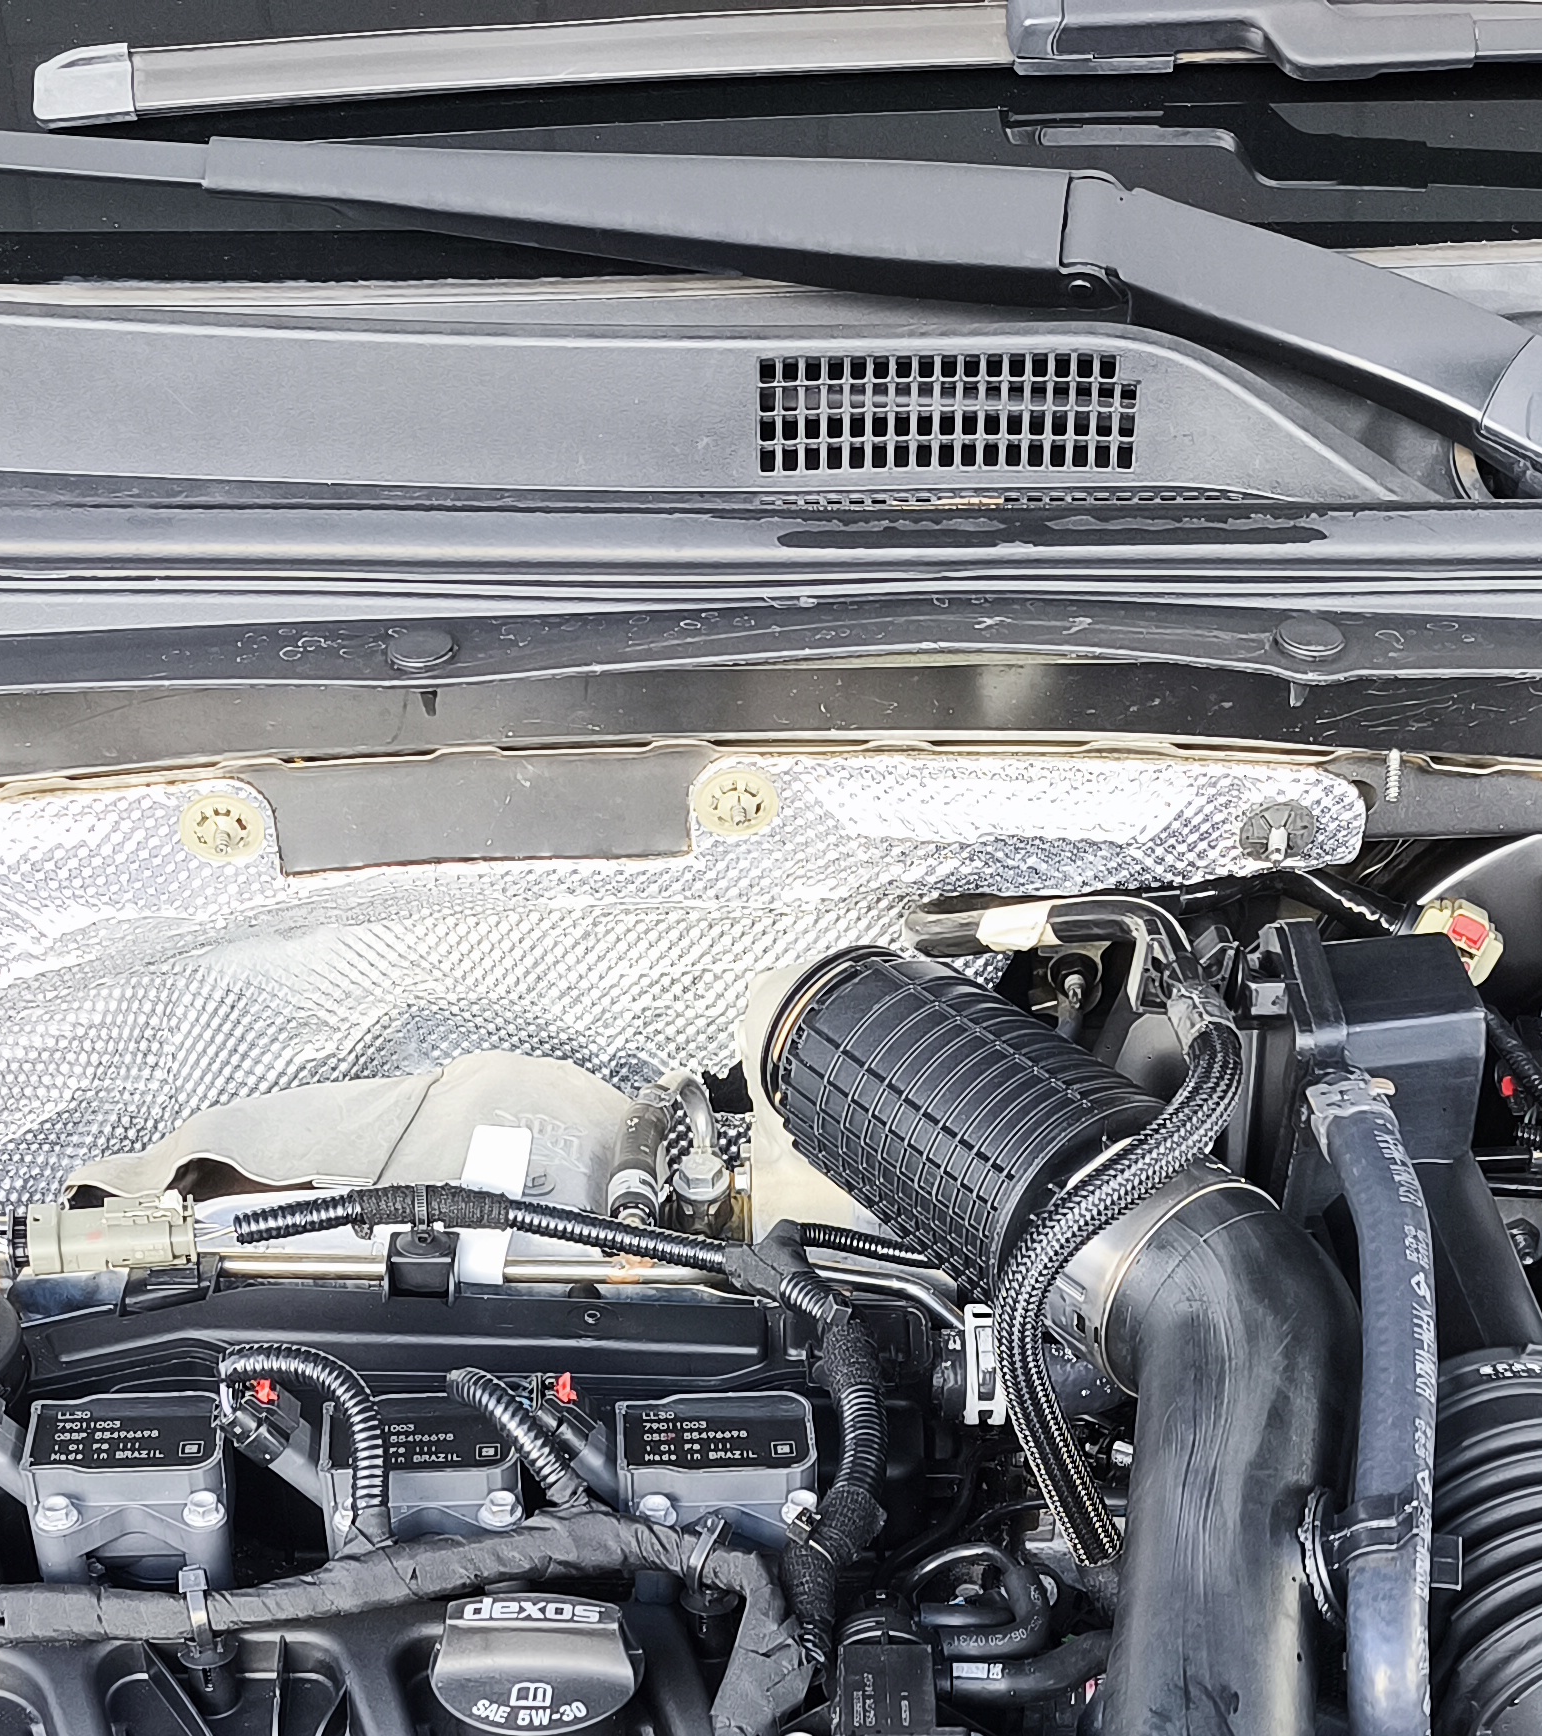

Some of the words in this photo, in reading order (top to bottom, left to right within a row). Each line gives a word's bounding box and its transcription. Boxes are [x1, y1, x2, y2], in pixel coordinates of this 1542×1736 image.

[642, 1412, 675, 1420] LL30
[643, 1421, 707, 1430] 79011003
[390, 1433, 454, 1443] 55496698
[51, 1452, 83, 1461] Made
[115, 1450, 164, 1459] BRAZIL
[413, 1453, 462, 1463] BRAZIL
[644, 1453, 677, 1462] Made
[709, 1450, 757, 1459] BRAZIL
[463, 1597, 601, 1623] dexos
[472, 1699, 511, 1724] SAE
[517, 1701, 588, 1726] 5W-30
